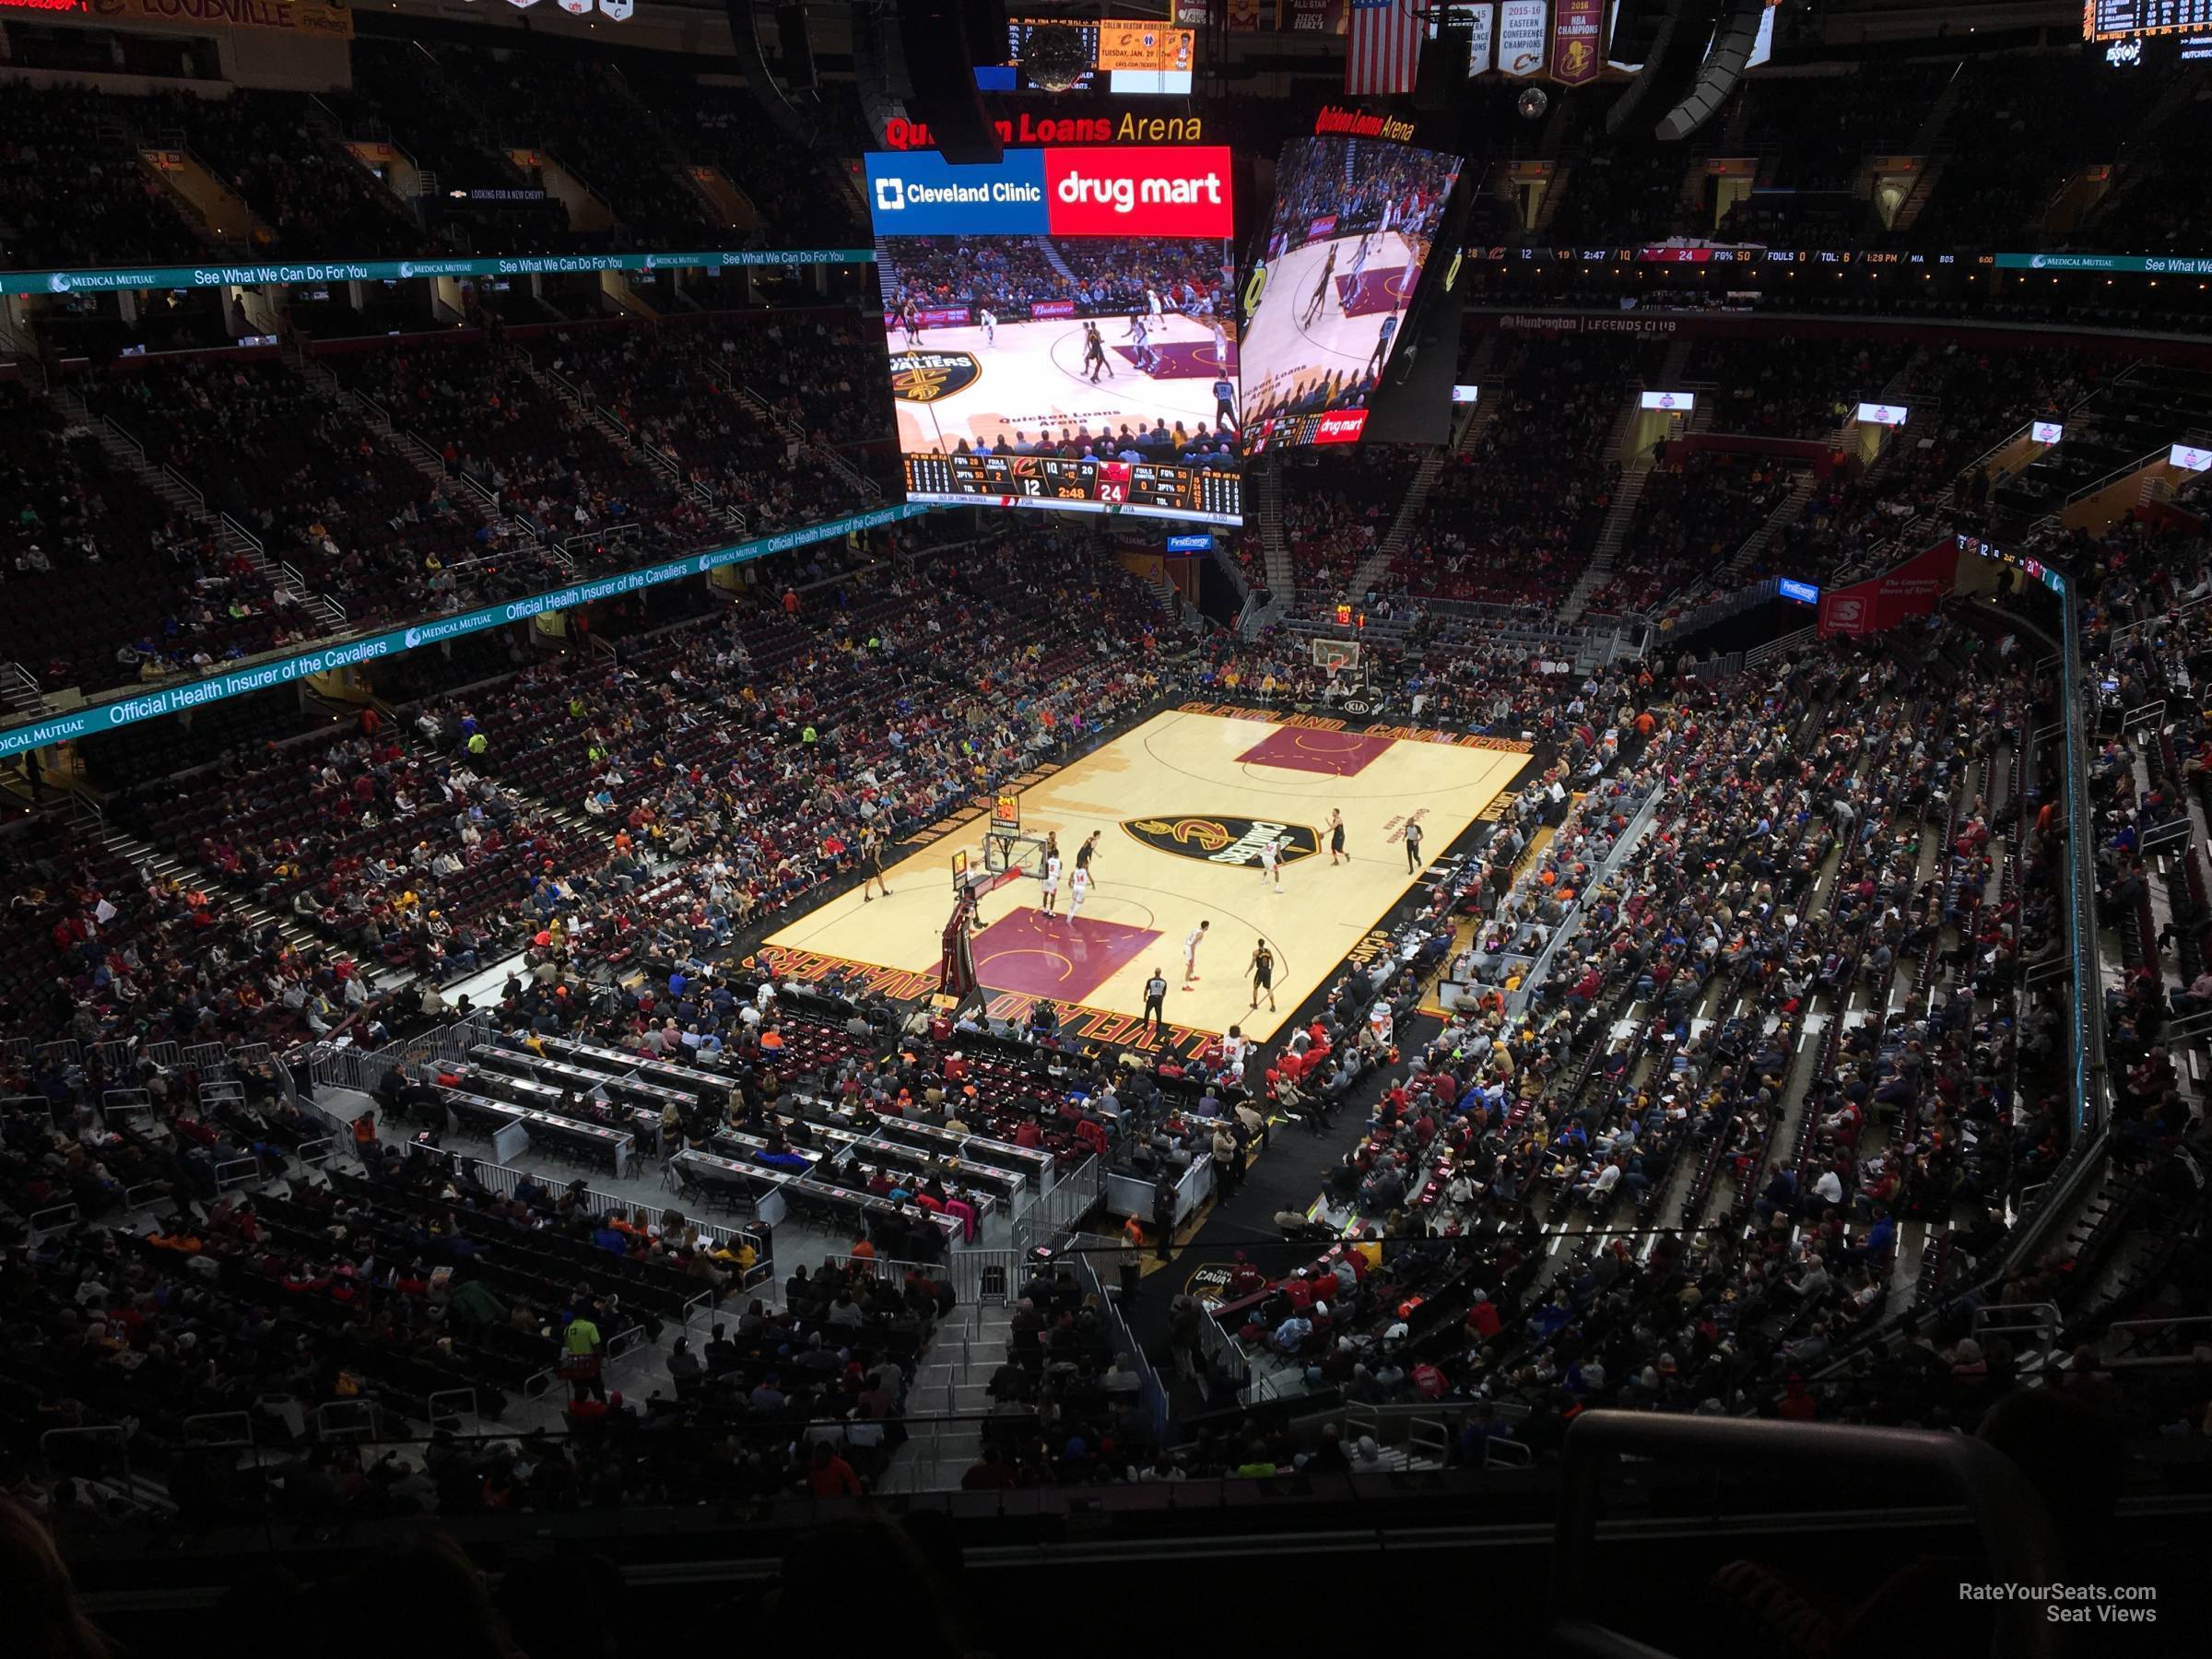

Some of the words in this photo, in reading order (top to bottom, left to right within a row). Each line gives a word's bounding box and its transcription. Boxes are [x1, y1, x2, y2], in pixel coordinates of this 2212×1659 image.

[1509, 6, 1541, 16] 2015-16
[1571, 2, 1589, 10] 2016
[1510, 18, 1539, 28] EASTERN
[1571, 16, 1586, 25] NBA
[1503, 29, 1544, 39] CONFERENCE
[1558, 25, 1598, 35] CHAMPIONS
[1503, 40, 1542, 49] CHAMPIONS
[1020, 113, 1112, 142] Loans
[1117, 112, 1202, 140] Arena
[1350, 109, 1384, 135] Loans
[1381, 114, 1415, 141] Arena
[471, 189, 495, 199] LOOKING
[496, 189, 505, 199] FOR
[512, 189, 524, 199] NEW
[524, 189, 545, 199] CHEVY?
[907, 182, 990, 203] Cleveland
[993, 182, 1041, 202] Clinic
[1058, 171, 1134, 213] drug
[1141, 172, 1221, 204] mart
[678, 256, 699, 265] MUTUAL
[723, 253, 739, 264] See
[741, 253, 764, 264] What
[765, 253, 780, 264] We
[781, 253, 798, 263] Can
[800, 253, 812, 263] Do
[814, 252, 828, 262] For
[829, 252, 844, 262] You
[1522, 249, 1532, 259] 12
[1558, 251, 1570, 259] 19
[1583, 251, 1606, 260] 2:47
[1620, 251, 1630, 261] 1Q
[1679, 251, 1693, 261] 24
[1714, 251, 1733, 261] FG%
[1736, 251, 1750, 261] 50
[1768, 252, 1794, 261] FOULS
[1800, 253, 1806, 262] 0
[1821, 253, 1839, 262] TOL:
[1843, 253, 1850, 262] 6
[1867, 253, 1883, 263] 1:29
[1885, 254, 1898, 263] PM
[1911, 254, 1924, 263] MIA
[414, 265, 444, 273] MEDICAL
[445, 264, 472, 273] MUTUAL
[500, 261, 517, 272] See
[519, 260, 542, 271] What
[544, 259, 559, 271] We
[559, 258, 578, 270] Can
[579, 258, 591, 269] Do
[592, 257, 606, 269] For
[606, 257, 623, 268] You
[2046, 257, 2080, 266] MEDICAL
[2081, 258, 2113, 267] MUTUAL
[2145, 259, 2165, 271] See
[2168, 259, 2195, 273] What
[2198, 260, 2212, 273] We
[72, 276, 115, 287] MEDICAL
[116, 276, 154, 286] MUTUAL
[194, 270, 220, 285] See
[222, 269, 255, 283] What
[257, 268, 277, 282] We
[280, 267, 305, 281] Can
[307, 266, 324, 280] Do
[325, 265, 345, 279] For
[346, 265, 368, 279] You
[1034, 303, 1074, 317] Budweiser
[1516, 315, 1576, 331] Huntington
[1588, 320, 1641, 332] LEGENDS
[999, 414, 1068, 424] Quicken
[1322, 419, 1340, 436] drug
[1341, 418, 1363, 431] mart
[955, 457, 969, 465] FG%
[1046, 462, 1058, 475] 1Q
[1081, 465, 1094, 475] 20
[1160, 468, 1174, 478] FG%
[1177, 471, 1187, 479] 50
[957, 471, 973, 479] 3PT%
[995, 472, 1002, 481] 2
[963, 485, 975, 493] TOL
[1024, 479, 1041, 496] 12
[1140, 480, 1147, 490] 0
[1158, 483, 1175, 492] 3PT%
[1176, 484, 1186, 493] 50
[1058, 487, 1085, 499] 2:48
[1100, 484, 1122, 501] 24
[1156, 497, 1168, 506] TOL
[768, 538, 794, 552] Official
[794, 531, 818, 546] Health
[819, 524, 843, 539] Insurer
[844, 520, 853, 530] of
[853, 517, 865, 529] the
[865, 510, 895, 526] Cavaliers
[1171, 537, 1210, 548] FirstEnergy
[710, 553, 736, 566] MEDICAL
[736, 546, 759, 559] MUTUAL
[421, 625, 459, 641] MEDICAL
[459, 614, 492, 632] MUTUAL
[507, 599, 544, 620] Official
[546, 590, 580, 610] Health
[582, 582, 612, 602] Insurer
[617, 577, 628, 590] of
[629, 573, 644, 588] the
[646, 563, 688, 583] Cavaliers
[1338, 612, 1349, 623] 19
[33, 719, 85, 743] MUTUAL
[110, 696, 168, 725] Official
[171, 682, 223, 709] Health
[226, 669, 279, 696] Insurer
[281, 660, 298, 680] of
[299, 654, 322, 675] the
[324, 640, 388, 672] Cavaliers
[1348, 700, 1365, 712] KIA
[1177, 701, 1347, 731] CLEVELAND
[1365, 724, 1535, 755] CAVALIERS
[999, 795, 1015, 806] 2:47
[1208, 821, 1288, 865] CAVALIERS
[1225, 1046, 1237, 1054] 42
